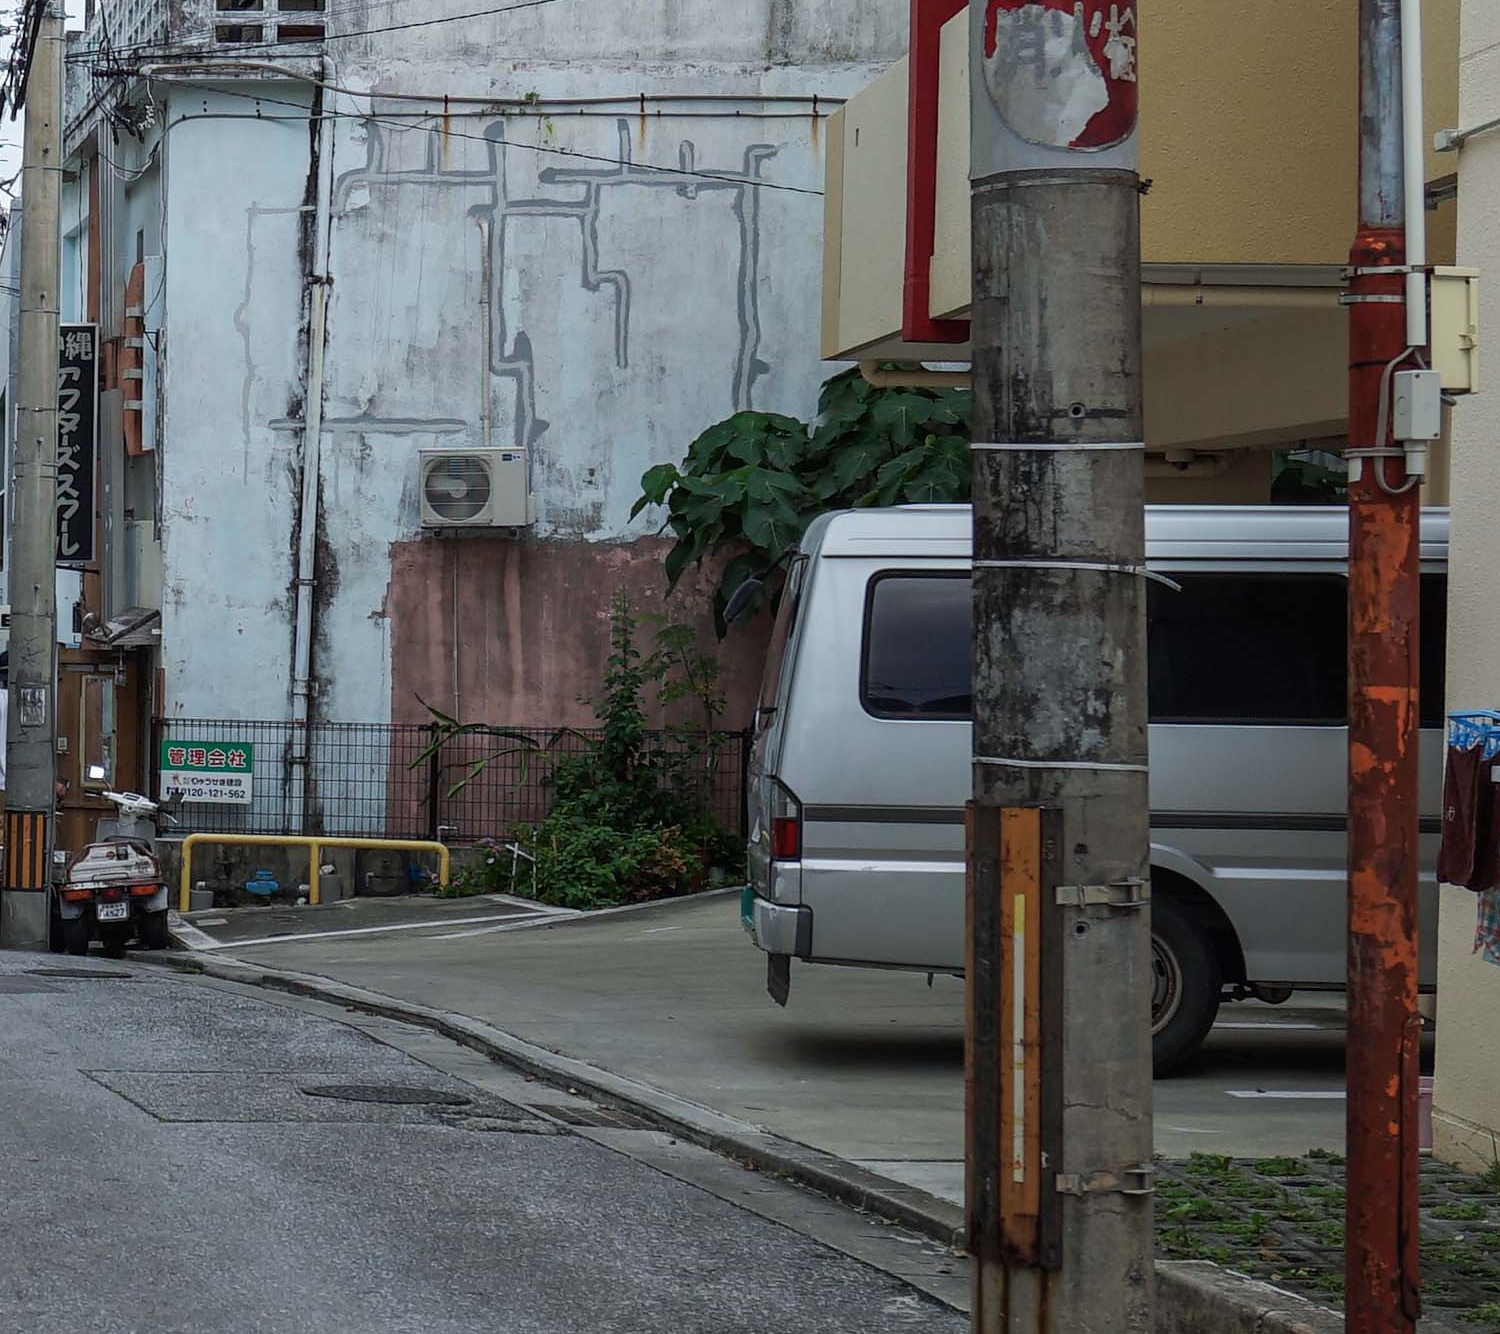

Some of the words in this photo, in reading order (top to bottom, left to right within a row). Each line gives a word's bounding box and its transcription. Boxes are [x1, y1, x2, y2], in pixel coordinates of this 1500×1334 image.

[60, 331, 93, 360] 縄
[168, 747, 247, 768] 管理会社
